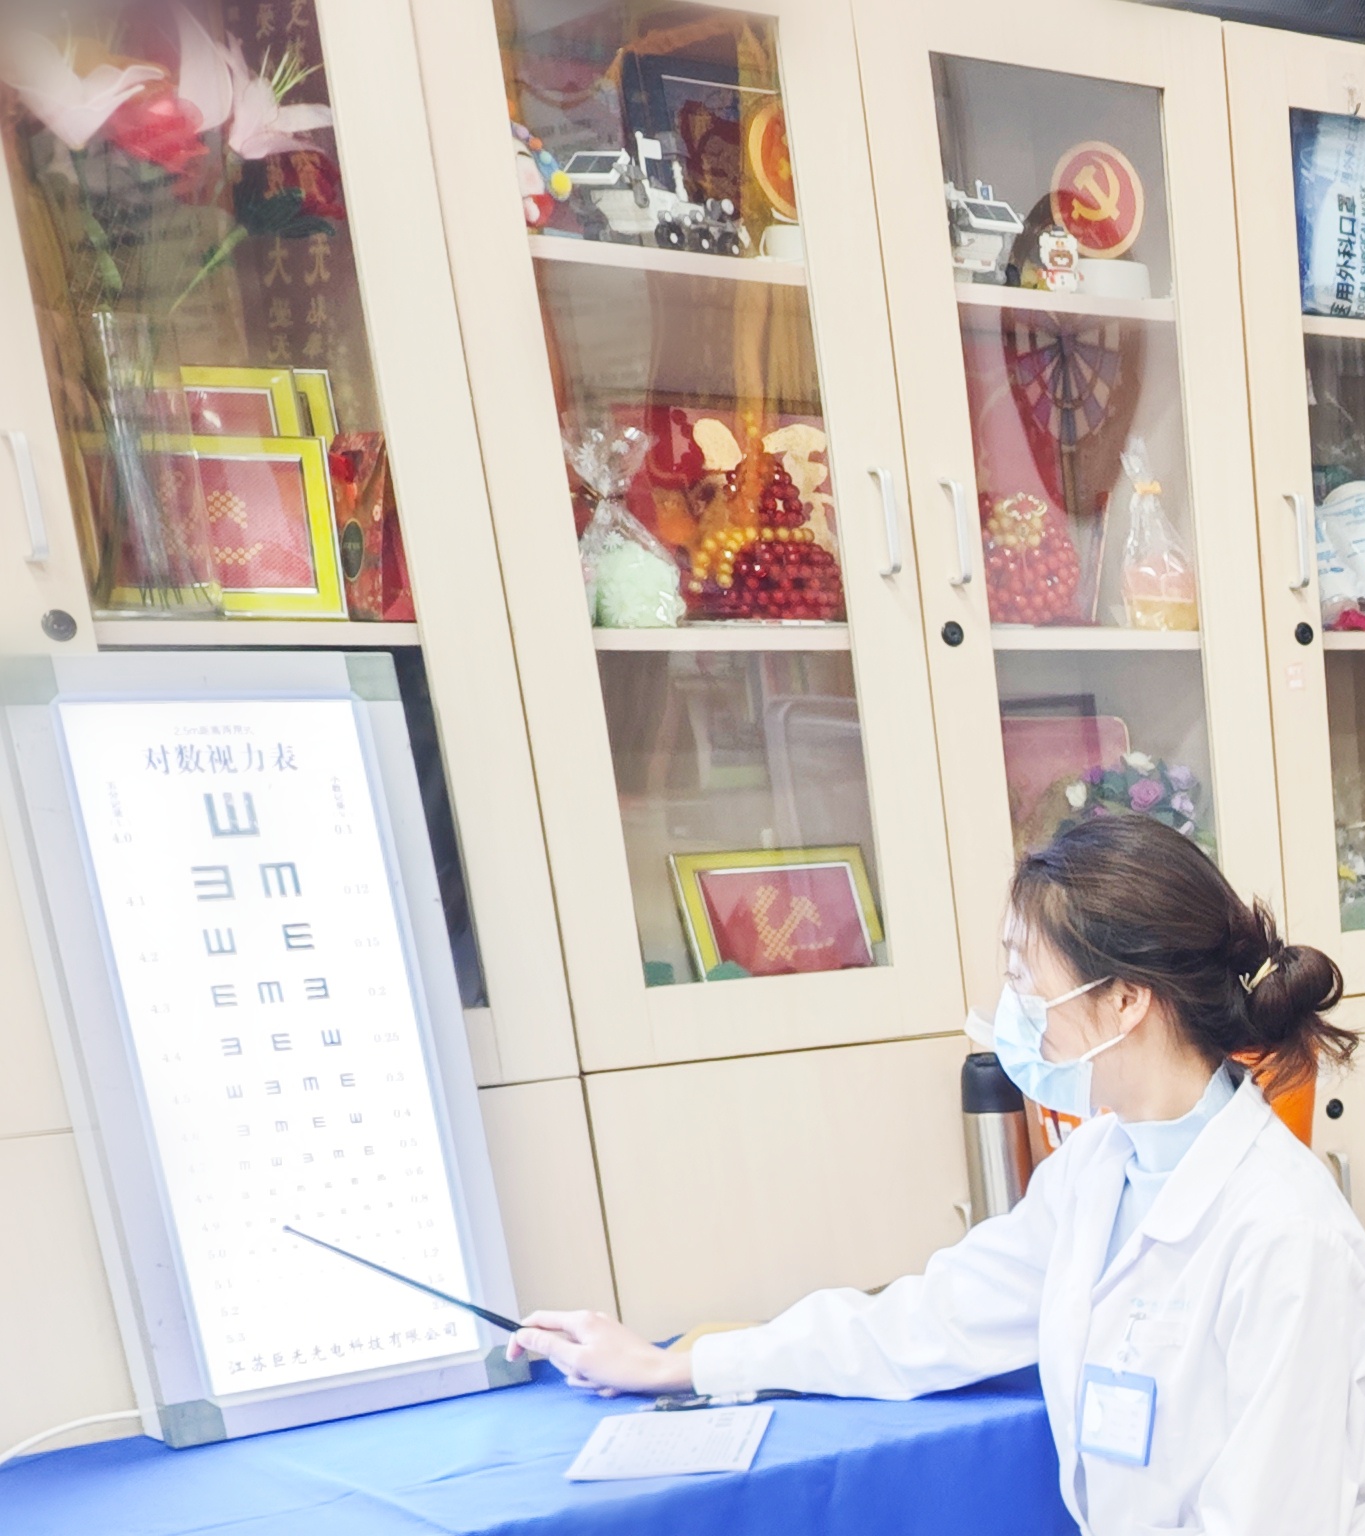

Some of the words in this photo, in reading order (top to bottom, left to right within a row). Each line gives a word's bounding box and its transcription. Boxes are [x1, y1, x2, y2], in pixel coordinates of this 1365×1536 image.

[143, 742, 298, 775] 对数视力表
[112, 832, 133, 844] 4.0
